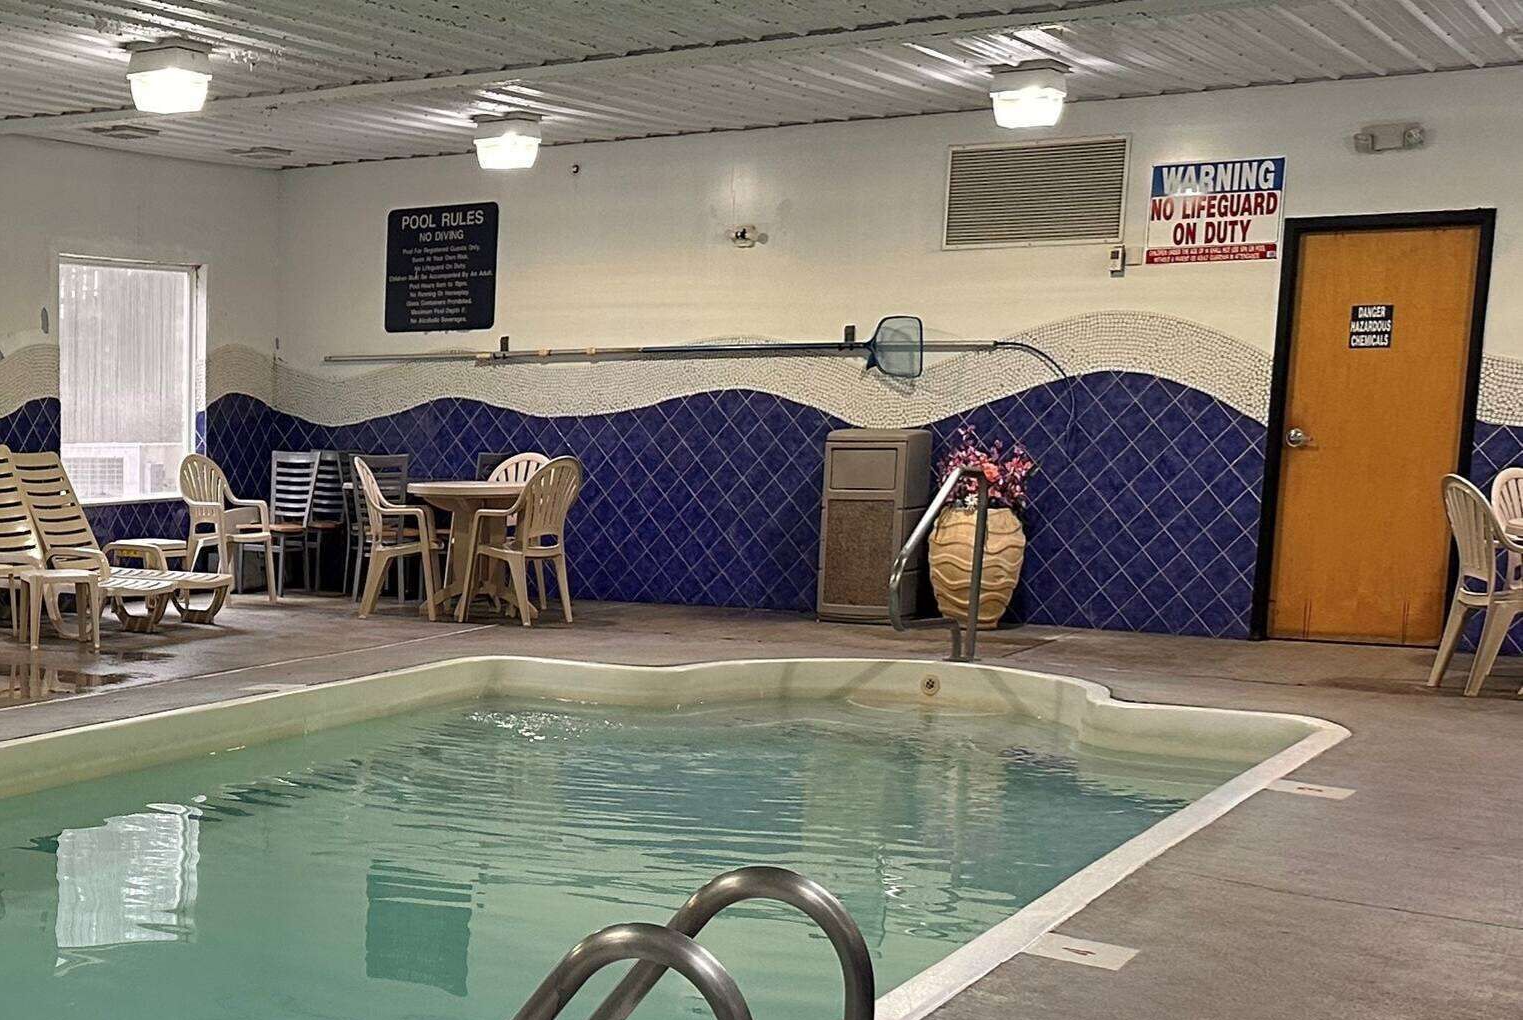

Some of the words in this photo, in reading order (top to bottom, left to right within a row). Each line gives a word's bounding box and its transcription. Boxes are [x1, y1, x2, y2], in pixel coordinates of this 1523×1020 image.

[1162, 160, 1275, 195] WARNING
[1151, 197, 1174, 221] NO
[1182, 192, 1278, 219] LIFEGUARD
[402, 214, 436, 230] POOL
[441, 210, 484, 227] RULES
[419, 232, 432, 242] NO
[435, 230, 464, 241] DIVING
[1173, 222, 1196, 245] ON
[1204, 219, 1252, 244] DUTY
[1358, 305, 1386, 318] DANGER
[1350, 320, 1391, 332] HAZARDOUS
[1351, 334, 1389, 347] CHEMICALS
